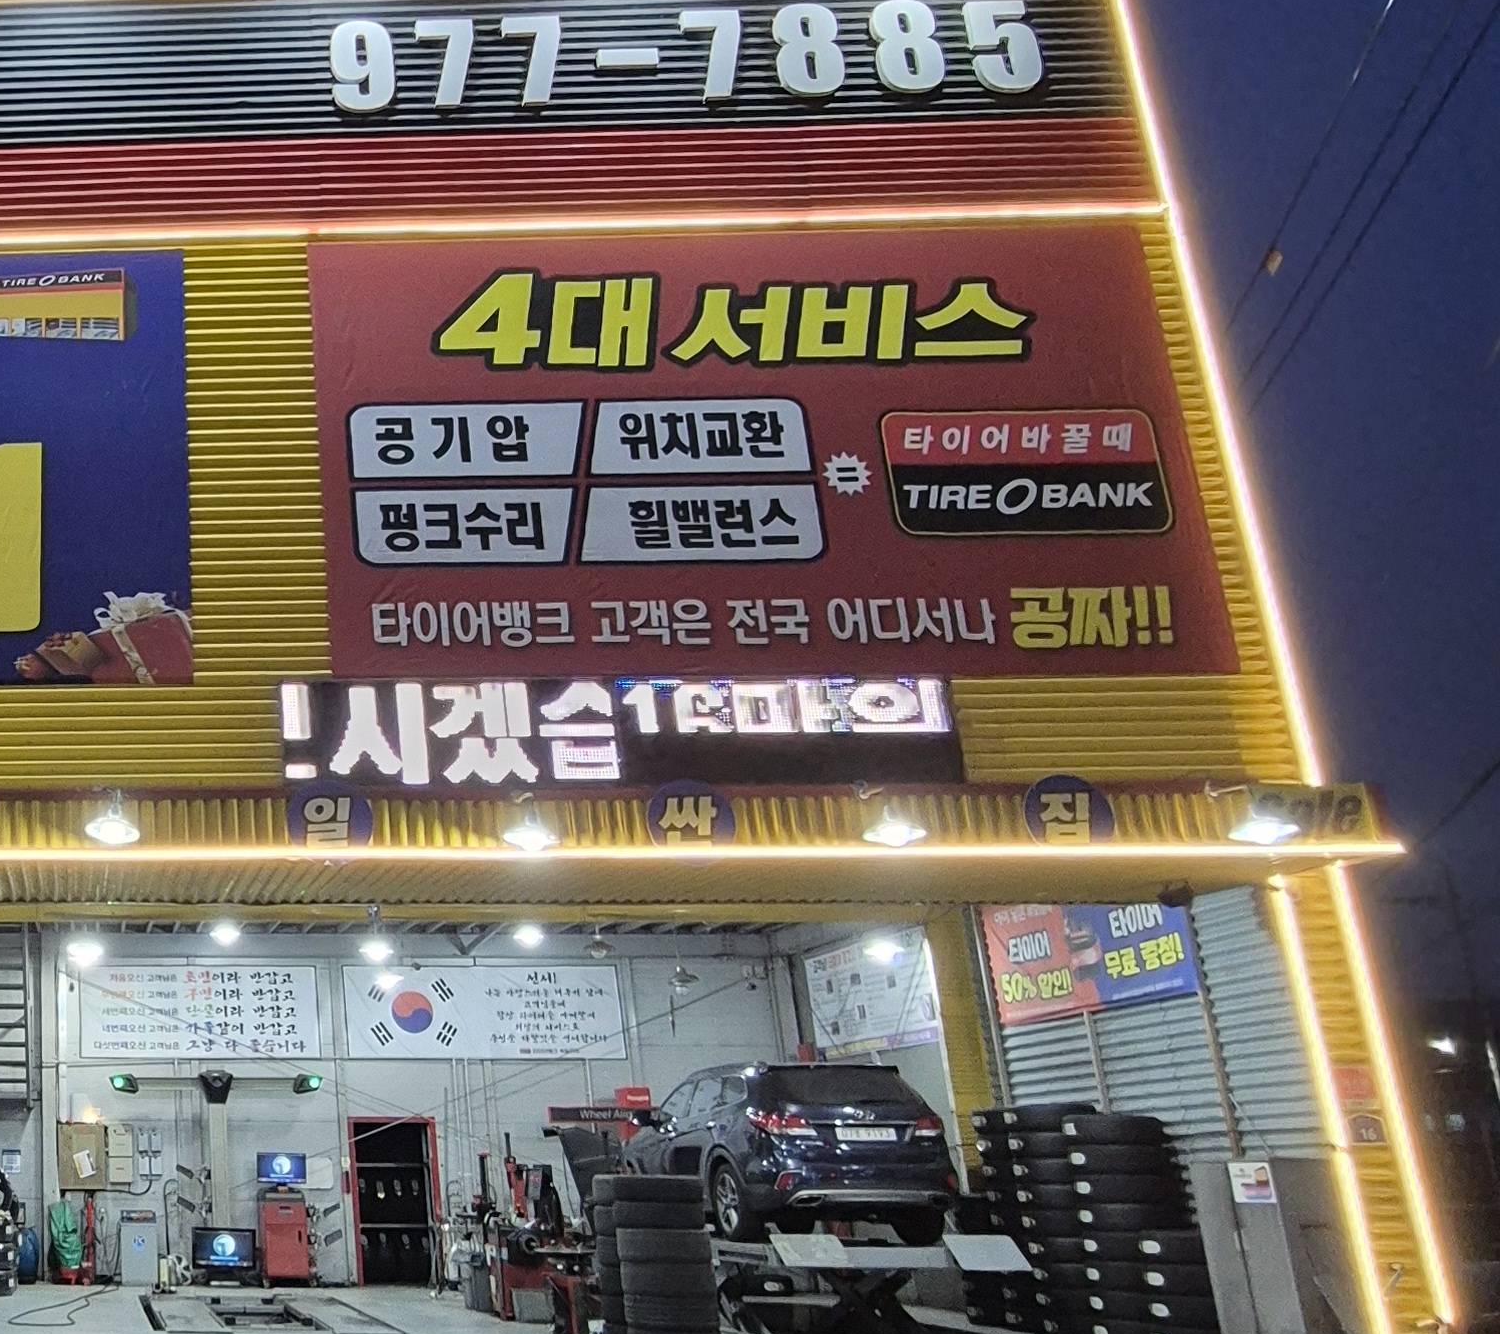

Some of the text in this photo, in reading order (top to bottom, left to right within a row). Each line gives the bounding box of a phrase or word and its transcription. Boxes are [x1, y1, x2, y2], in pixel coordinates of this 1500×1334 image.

[329, 0, 1043, 114] 977-7885
[434, 269, 1033, 371] 4대 서비스
[375, 414, 530, 463] 공기압
[619, 411, 783, 460] 위치교환
[380, 500, 544, 552] 펑크수리
[629, 496, 801, 548] 휠밸런스
[373, 586, 1173, 650] 타이어뱅크 고객은 전국 어디서나 공짜!!
[1008, 930, 1051, 964] 타이어
[1104, 932, 1185, 979] 무료 증정!
[1000, 968, 1073, 1003] 50% 할인!
[1360, 1128, 1377, 1141] 16
